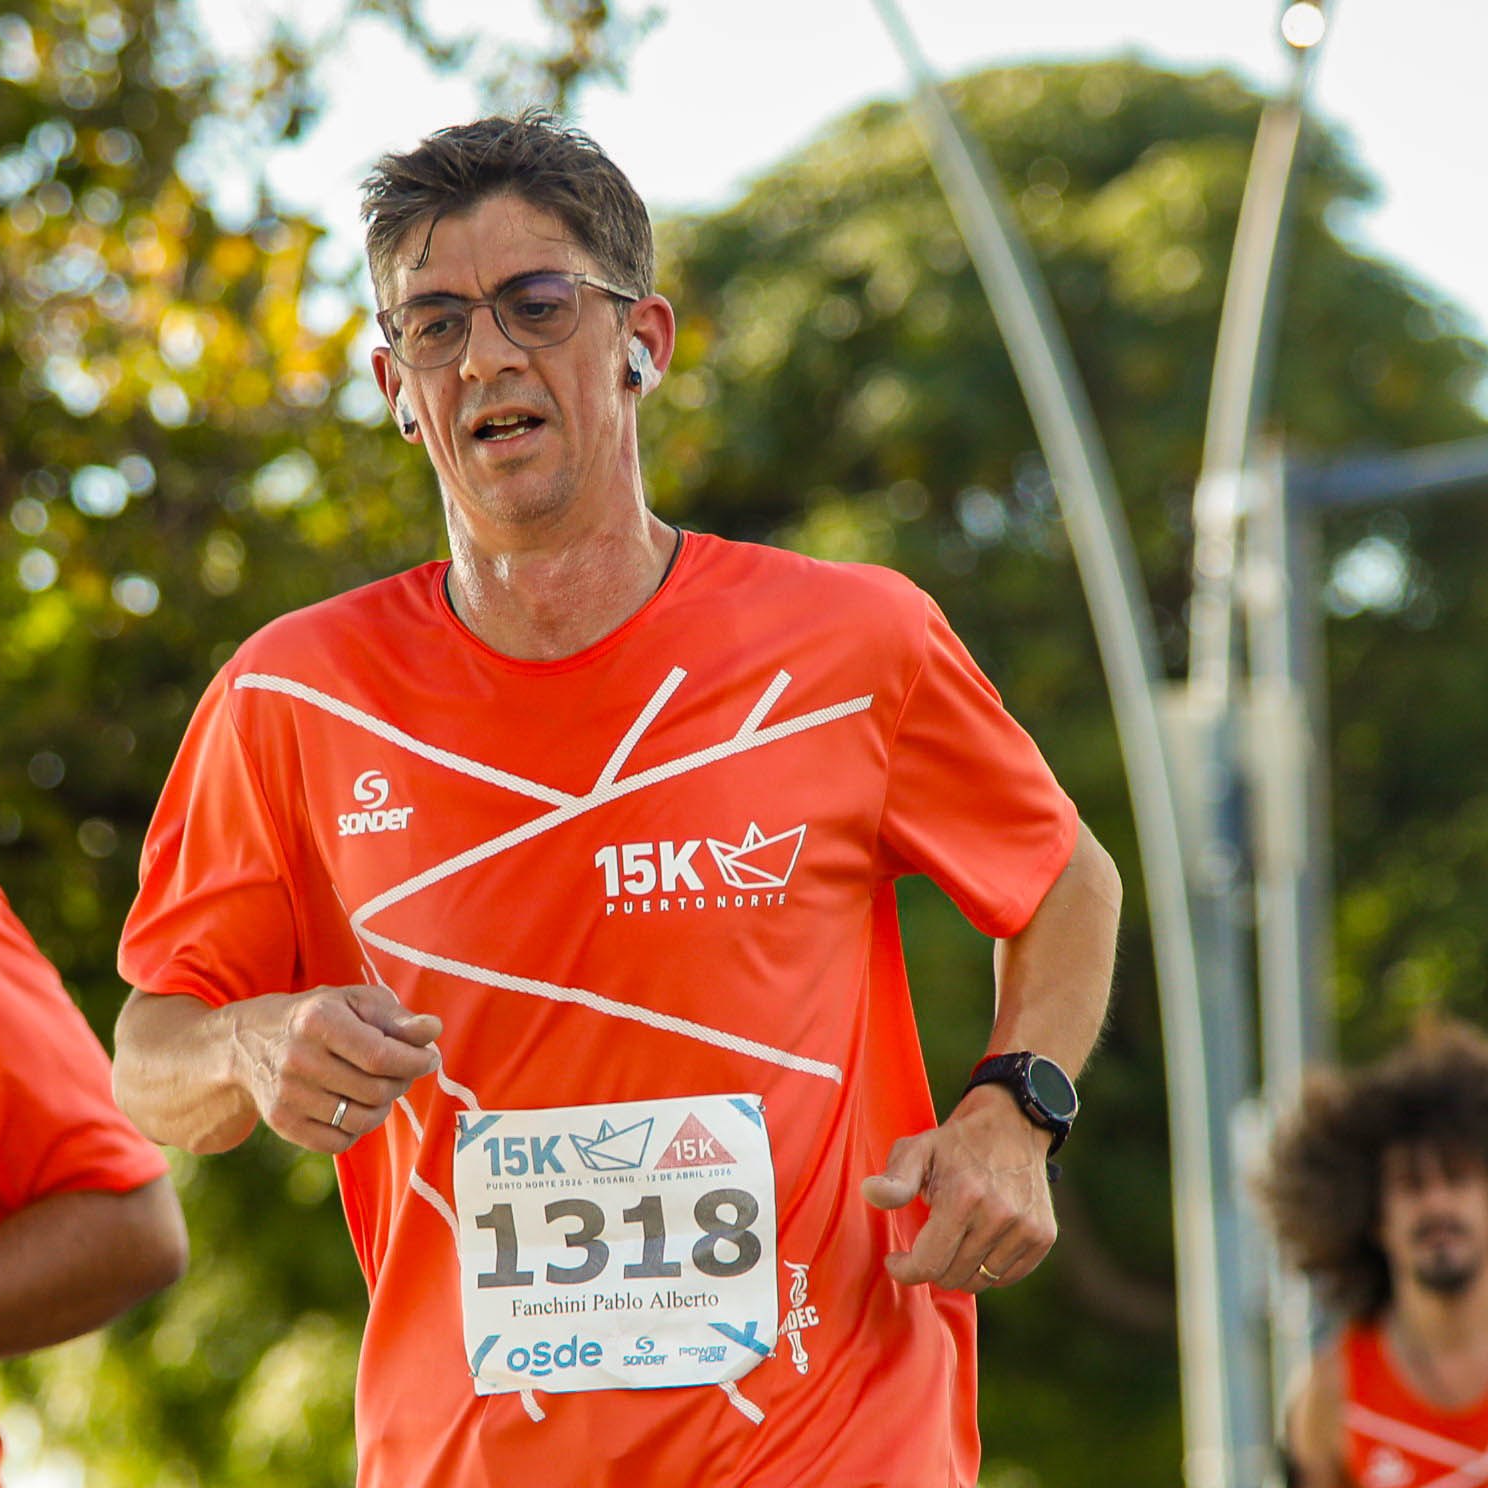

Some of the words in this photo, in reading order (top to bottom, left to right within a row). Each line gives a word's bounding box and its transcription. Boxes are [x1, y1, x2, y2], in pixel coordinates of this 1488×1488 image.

[595, 839, 705, 898] 15K
[483, 1134, 567, 1176] 15K
[671, 1136, 716, 1162] 15K
[486, 1181, 522, 1190] PUERTO
[525, 1180, 557, 1189] NORTE
[593, 1175, 635, 1185] ROSARIO
[660, 1172, 673, 1182] DE
[675, 1169, 705, 1181] ABRIL
[708, 1167, 733, 1178] 2026
[475, 1187, 762, 1289] 1318
[512, 1294, 587, 1317] Fanchini
[592, 1291, 643, 1312] Pablo
[650, 1290, 720, 1310] Alberto
[506, 1333, 603, 1373] osde
